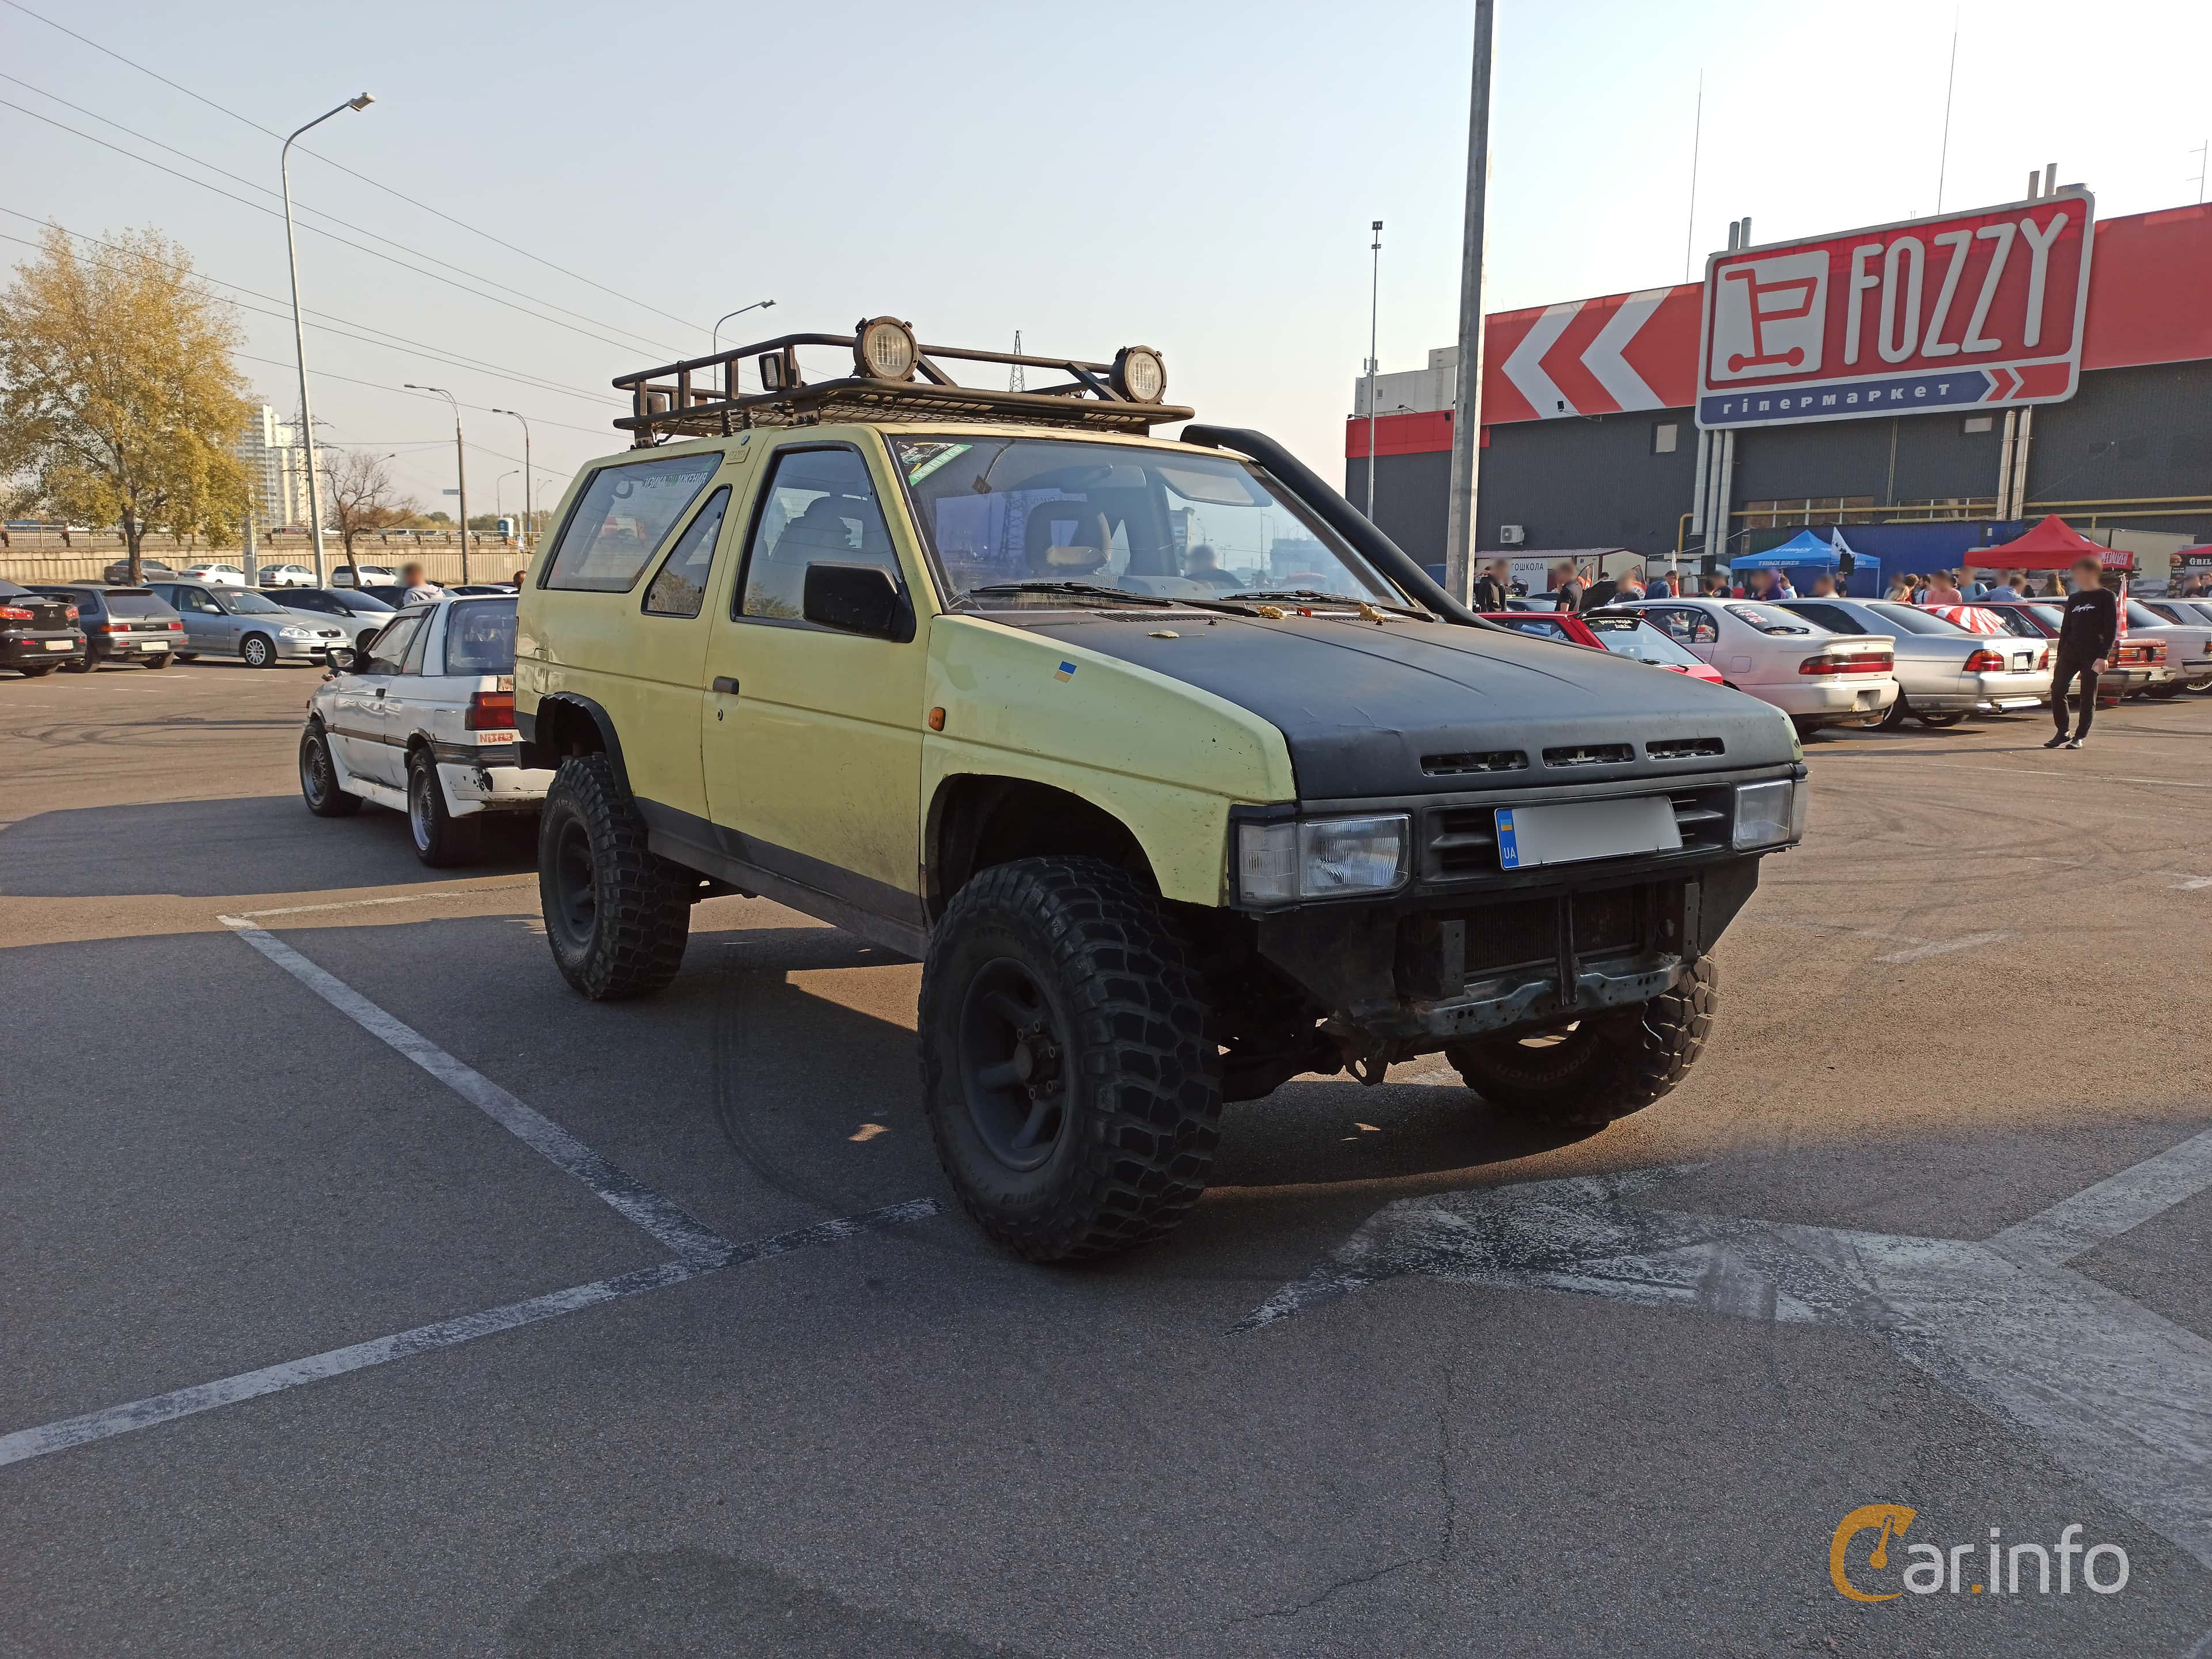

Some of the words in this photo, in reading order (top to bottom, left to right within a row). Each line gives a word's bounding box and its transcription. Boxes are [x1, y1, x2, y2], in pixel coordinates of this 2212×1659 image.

[1844, 212, 2069, 366] FOZZY
[1724, 383, 1950, 414] гіпермаркет
[2101, 551, 2128, 565] PECIALIZED
[1503, 847, 1517, 859] UA
